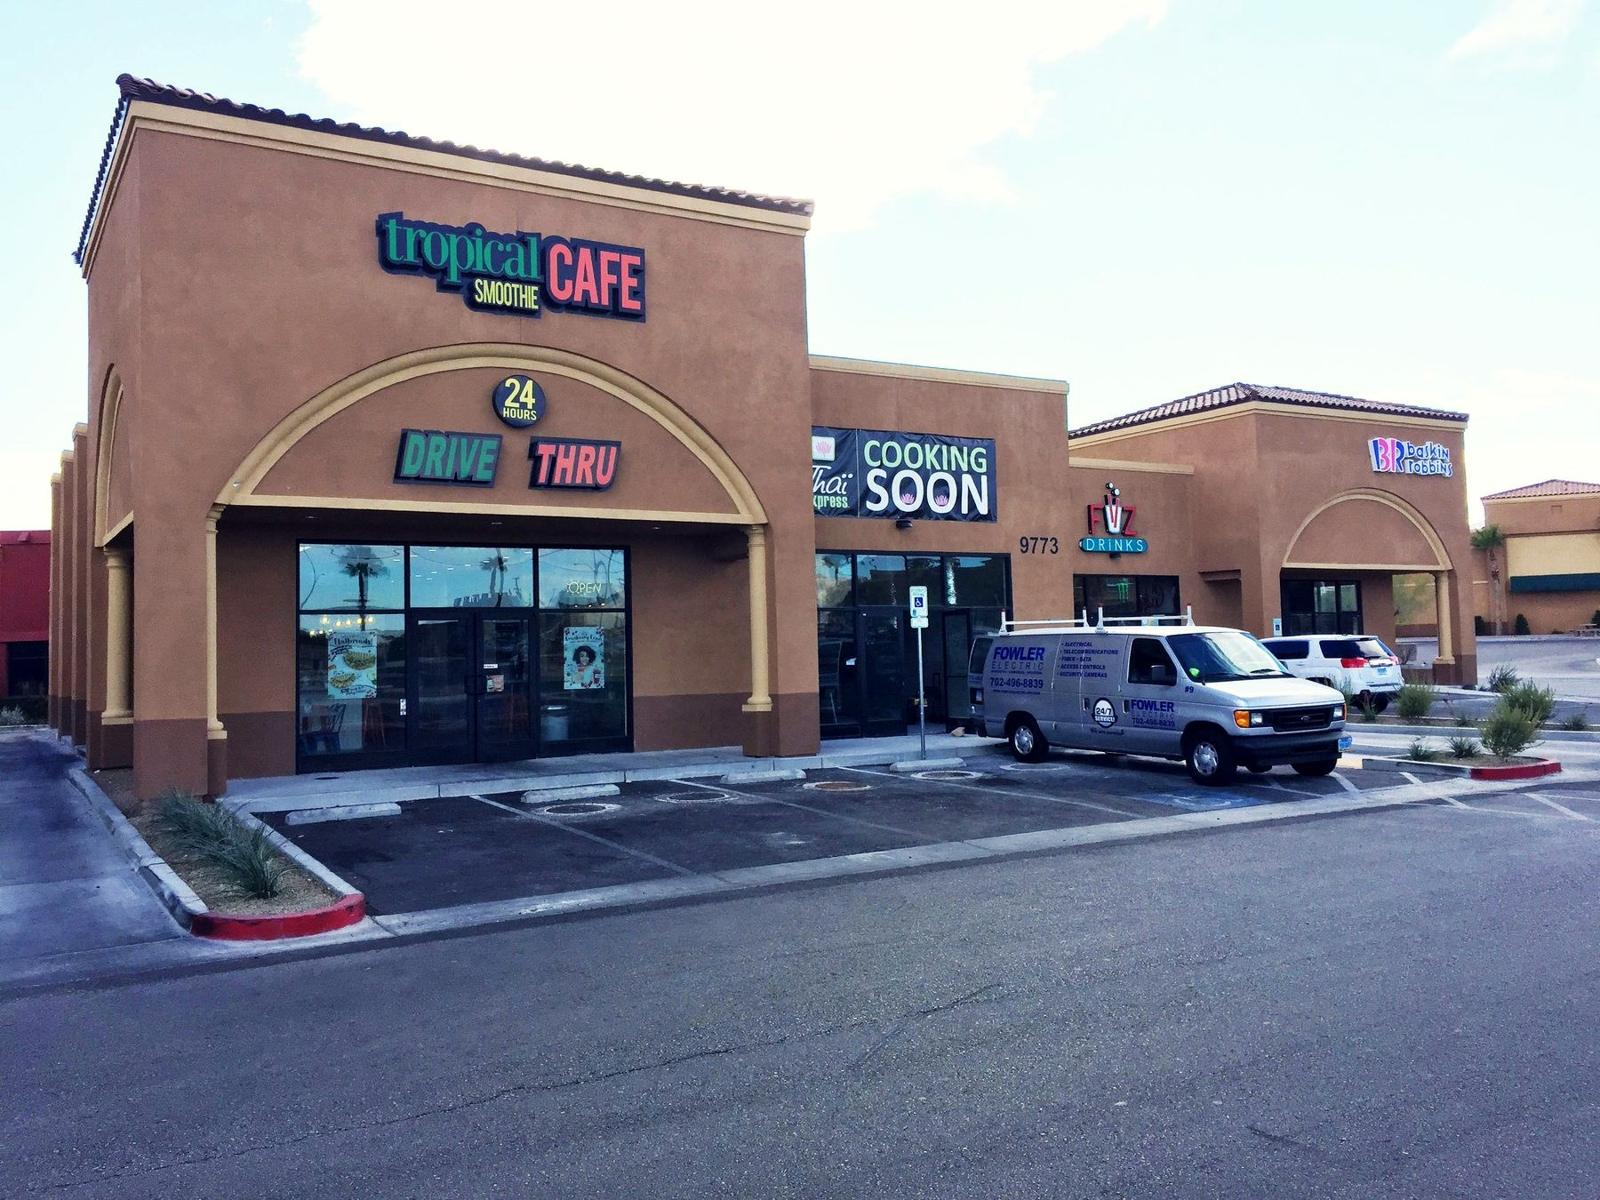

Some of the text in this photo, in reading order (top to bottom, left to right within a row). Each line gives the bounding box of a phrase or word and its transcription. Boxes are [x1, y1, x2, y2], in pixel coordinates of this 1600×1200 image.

[385, 218, 542, 284] tropical
[549, 242, 642, 311] CAFE
[474, 278, 539, 310] SMOOTHIE
[504, 377, 536, 410] 24
[502, 406, 537, 421] HOURS
[402, 431, 500, 481] DRIVE
[537, 443, 617, 486] THRU
[864, 439, 987, 474] COOKING
[866, 467, 989, 516] SOON
[1020, 536, 1059, 554] 9773
[567, 580, 602, 595] OPEN
[993, 646, 1046, 661] FOWLER
[991, 660, 1045, 671] ELECTRIC
[990, 676, 1044, 689] 702-496-8839
[1184, 685, 1195, 694] #9
[1095, 706, 1113, 716] 24/7
[1131, 699, 1175, 713] FOWLER
